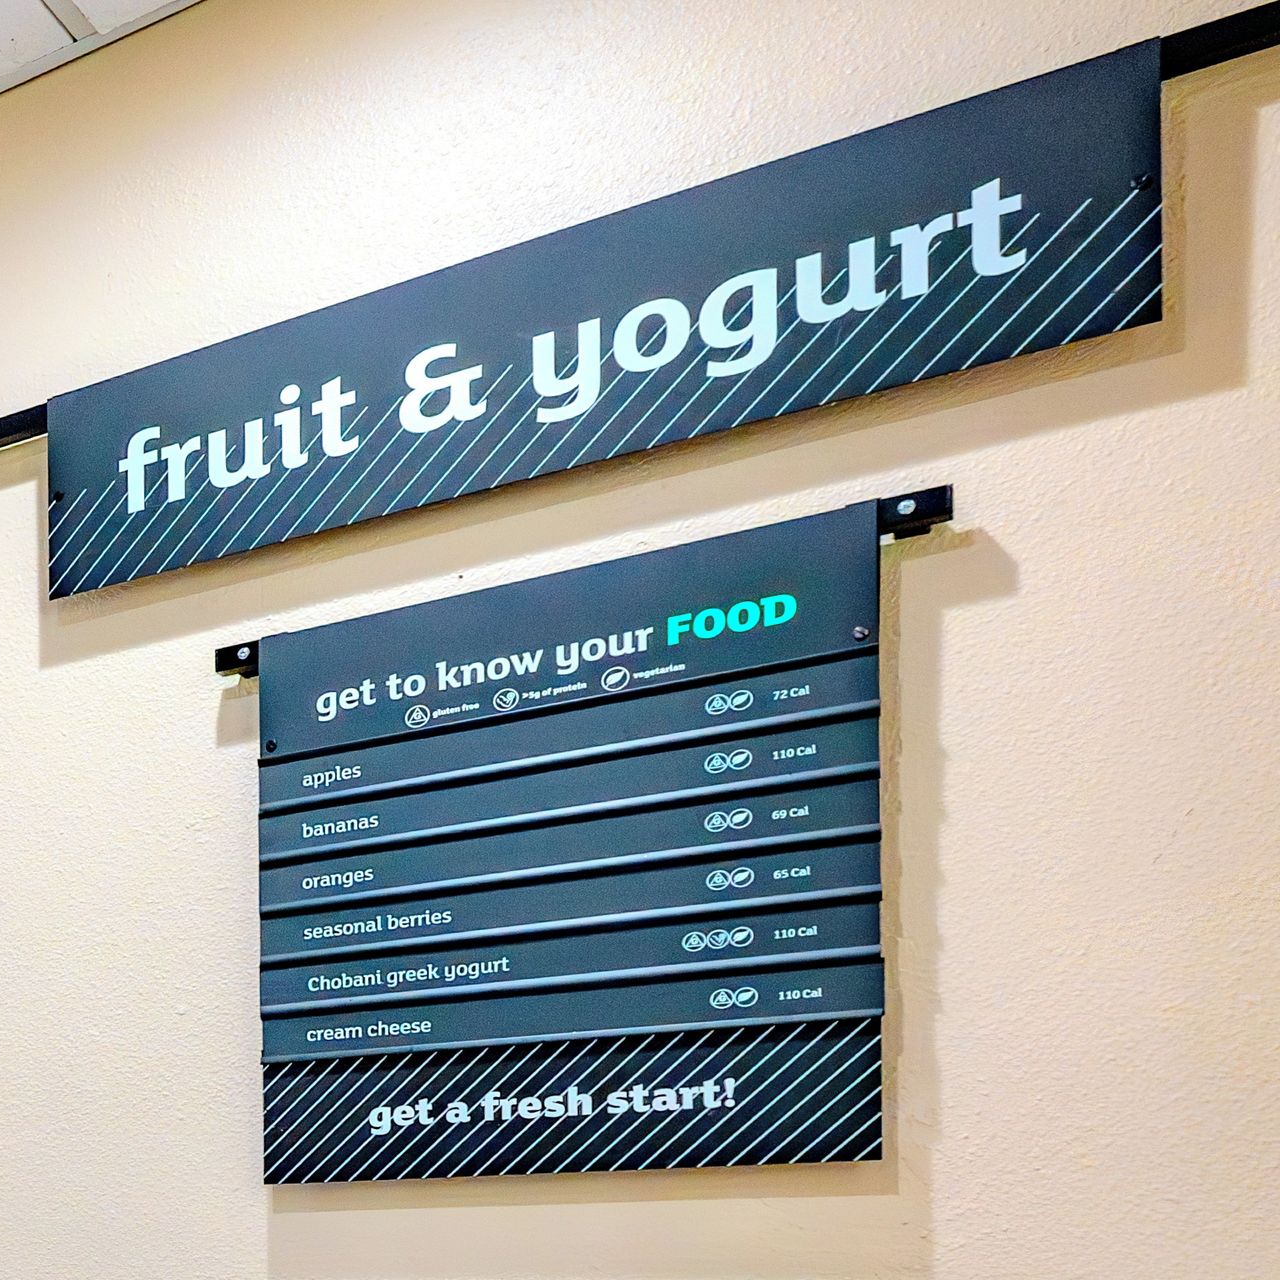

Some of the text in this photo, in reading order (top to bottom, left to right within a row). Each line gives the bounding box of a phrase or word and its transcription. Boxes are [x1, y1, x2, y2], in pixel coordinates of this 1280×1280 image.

[118, 178, 1026, 514] fruit & yogurt
[317, 595, 796, 721] get to know your FOOD
[633, 664, 686, 681] vegetarian
[542, 688, 551, 696] of
[553, 681, 587, 696] protein
[772, 685, 810, 701] 72 Cal
[432, 702, 479, 719] gluten free
[772, 744, 816, 760] 110 Cal
[303, 766, 362, 790] apples
[772, 806, 809, 820] 69 Cal
[302, 816, 380, 840] bananas
[302, 869, 375, 891] oranges
[773, 866, 810, 879] 65 Cal
[304, 910, 451, 939] seasonal berries
[773, 926, 818, 939] 110 Cal
[308, 957, 511, 991] Chobani greek yogurt
[778, 988, 822, 1001] 110 Cal
[306, 1017, 432, 1043] cream cheese
[368, 1077, 737, 1135] get a fresh start!
